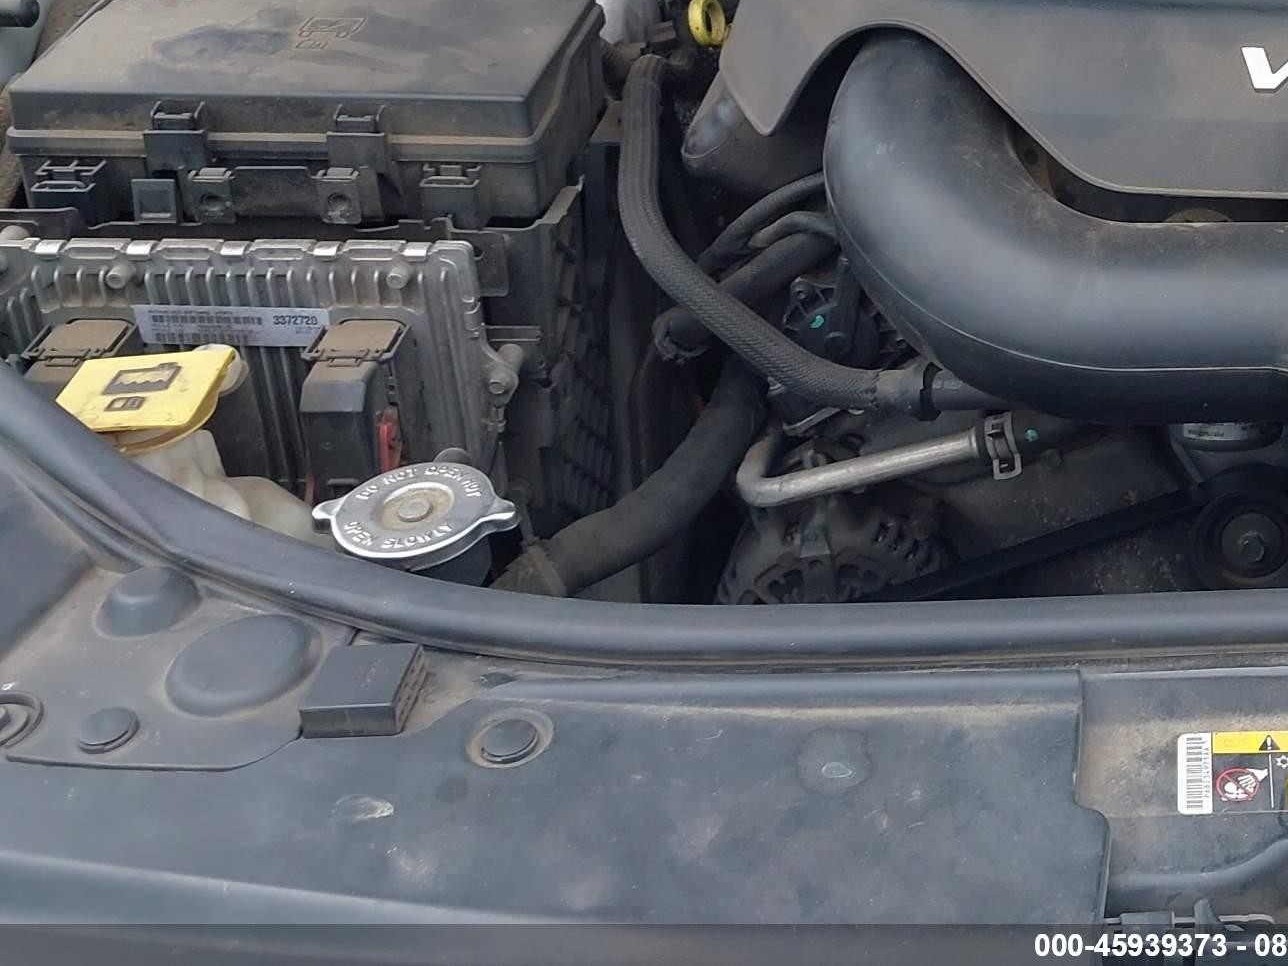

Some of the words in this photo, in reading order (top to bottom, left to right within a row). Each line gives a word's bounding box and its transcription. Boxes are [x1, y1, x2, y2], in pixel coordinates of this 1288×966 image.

[355, 485, 380, 500] DO
[382, 468, 418, 485] NOT
[425, 465, 462, 481] OPEN
[461, 479, 482, 497] HOT
[344, 521, 374, 546] OPEN
[381, 522, 453, 549] SLOWLY
